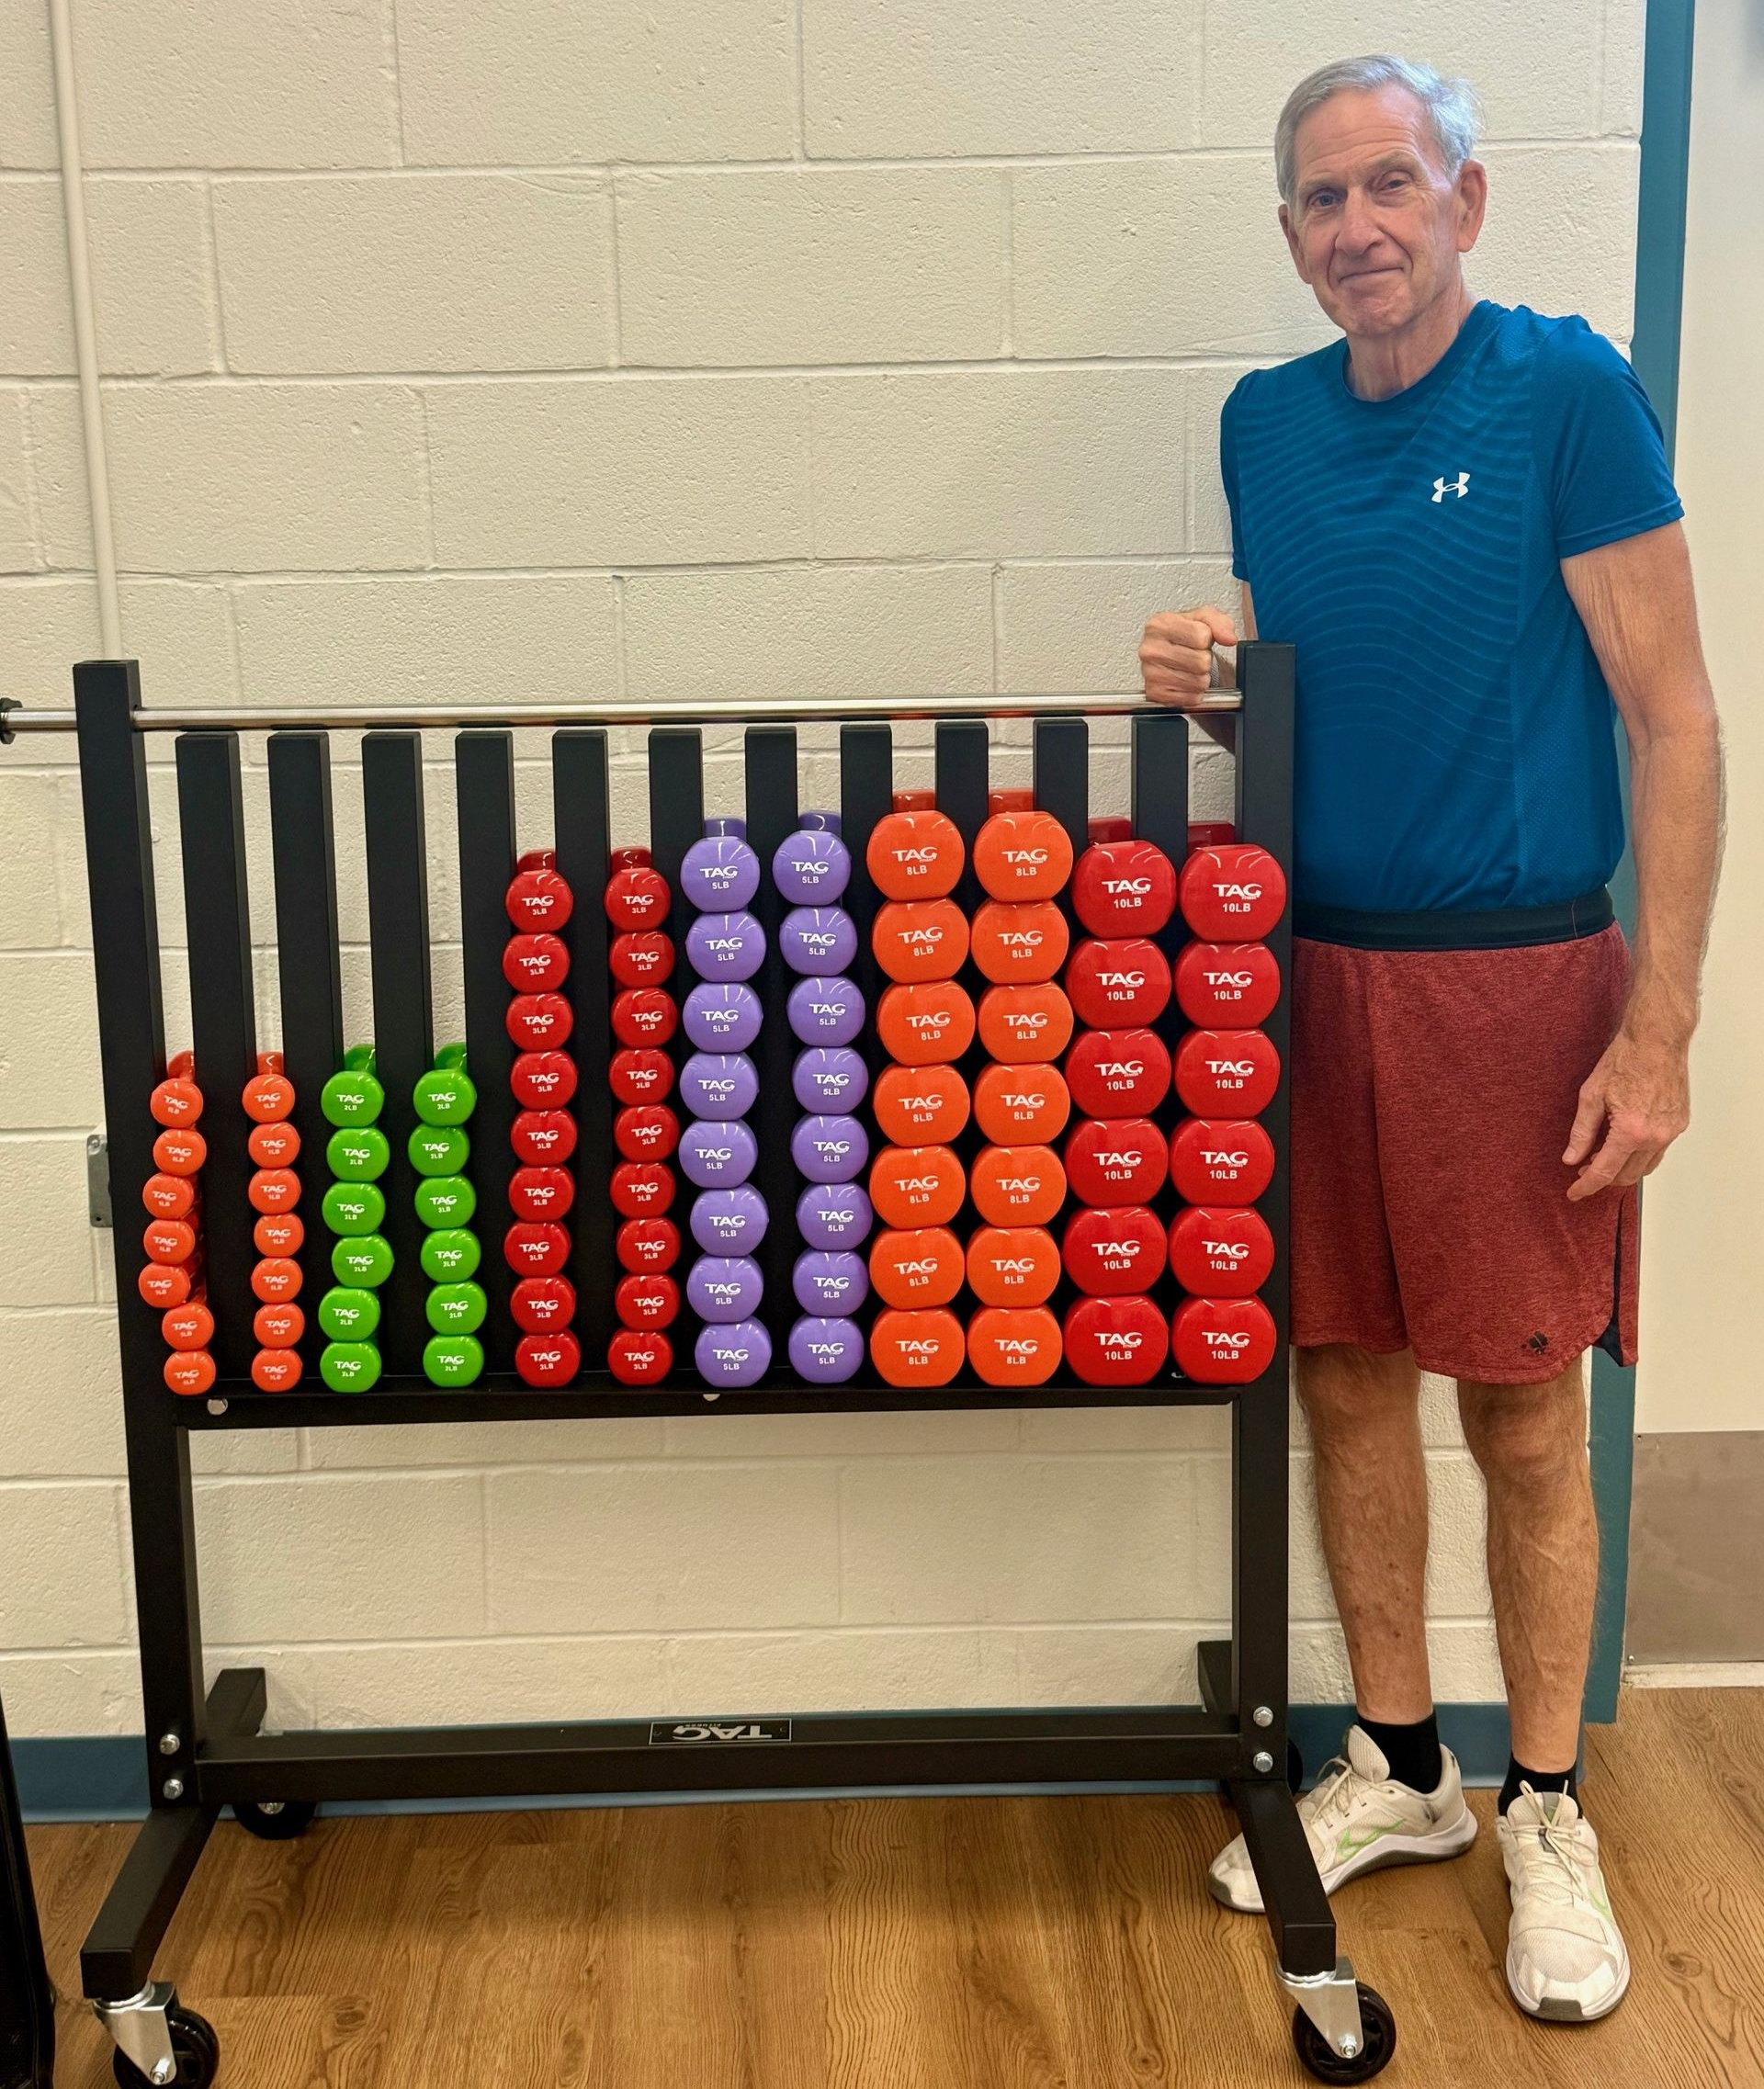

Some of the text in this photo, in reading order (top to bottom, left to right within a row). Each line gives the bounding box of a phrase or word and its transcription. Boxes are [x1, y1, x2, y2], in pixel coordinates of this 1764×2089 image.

[892, 847, 937, 862] TAG
[1002, 849, 1047, 864] TAG
[700, 865, 738, 878] TAG
[791, 861, 829, 874] TAG
[907, 865, 927, 875] 8LB
[1017, 867, 1036, 876] 8LB
[713, 882, 729, 890] 5LB
[1102, 878, 1150, 894] TAG
[1213, 884, 1261, 899] TAG
[522, 896, 553, 906] TAG
[623, 895, 653, 905] TAG
[1114, 898, 1141, 908] 10LB
[1223, 903, 1250, 912] 10LB
[799, 932, 836, 945] TAG
[898, 927, 943, 943] TAG
[998, 931, 1043, 945] TAG
[706, 937, 742, 950] TAG
[914, 945, 933, 955] 8LB
[1012, 949, 1032, 957] 8LB
[519, 955, 550, 966] TAG
[628, 952, 659, 962] TAG
[718, 954, 735, 962] 5LB
[1096, 972, 1145, 988] TAG
[1204, 971, 1252, 987] TAG
[1107, 990, 1134, 1000] 10LB
[1214, 990, 1241, 999] 10LB
[809, 1004, 845, 1015] TAG
[523, 1014, 554, 1025] TAG
[632, 1011, 662, 1022] TAG
[702, 1010, 738, 1022] TAG
[906, 1012, 950, 1027] TAG
[1003, 1013, 1047, 1027] TAG
[820, 1018, 837, 1026] 5LB
[642, 1023, 656, 1032] 3LB
[922, 1031, 941, 1040] 8LB
[1017, 1031, 1036, 1039] 8LB
[1095, 1060, 1143, 1077] TAG
[1205, 1061, 1253, 1076] TAG
[528, 1073, 559, 1083] TAG
[627, 1069, 657, 1080] TAG
[698, 1079, 735, 1091] TAG
[813, 1074, 849, 1086] TAG
[1107, 1079, 1134, 1090] 10LB
[1216, 1079, 1243, 1089] 10LB
[337, 1095, 364, 1104] TAG
[428, 1092, 456, 1101] TAG
[1001, 1094, 1045, 1108] TAG
[899, 1095, 943, 1110] TAG
[913, 1112, 933, 1122] 8LB
[1014, 1112, 1034, 1120] 8LB
[632, 1124, 662, 1136] TAG
[527, 1130, 558, 1141] TAG
[642, 1137, 656, 1146] 3LB
[423, 1143, 449, 1152] TAG
[813, 1141, 849, 1153] TAG
[343, 1148, 370, 1158] TAG
[695, 1148, 731, 1160] TAG
[1093, 1151, 1141, 1167] TAG
[1200, 1152, 1248, 1167] TAG
[1105, 1170, 1132, 1180] 10LB
[1210, 1170, 1237, 1179] 10LB
[628, 1182, 658, 1193] TAG
[895, 1176, 938, 1191] TAG
[997, 1177, 1040, 1191] TAG
[525, 1187, 554, 1197] TAG
[430, 1195, 457, 1205] TAG
[910, 1193, 929, 1203] 8LB
[1011, 1194, 1029, 1203] 8LB
[337, 1204, 364, 1214] TAG
[709, 1215, 745, 1227] TAG
[818, 1211, 854, 1222] TAG
[519, 1242, 549, 1252] TAG
[635, 1241, 665, 1251] TAG
[1091, 1240, 1139, 1256] TAG
[1202, 1241, 1249, 1259] TAG
[435, 1250, 462, 1259] TAG
[346, 1256, 373, 1265] TAG
[991, 1259, 1034, 1272] TAG
[1103, 1259, 1131, 1270] 10LB
[1211, 1260, 1237, 1270] 10LB
[894, 1259, 937, 1274] TAG
[813, 1277, 849, 1289] TAG
[910, 1276, 929, 1286] 8LB
[1004, 1275, 1023, 1284] 8LB
[705, 1283, 741, 1295] TAG
[441, 1301, 468, 1310] TAG
[528, 1300, 558, 1310] TAG
[634, 1296, 664, 1306] TAG
[334, 1309, 359, 1318] TAG
[1094, 1332, 1142, 1348] TAG
[1202, 1332, 1250, 1348] TAG
[808, 1343, 843, 1354] TAG
[896, 1339, 939, 1353] TAG
[995, 1339, 1037, 1354] TAG
[530, 1351, 560, 1361] TAG
[625, 1351, 654, 1361] TAG
[713, 1349, 749, 1361] TAG
[1105, 1351, 1132, 1360] 10LB
[1212, 1350, 1238, 1359] 10LB
[437, 1356, 464, 1364] TAG
[820, 1357, 836, 1365] 5LB
[909, 1356, 928, 1364] 8LB
[334, 1361, 361, 1371] TAG
[673, 1725, 772, 1741] TAG
